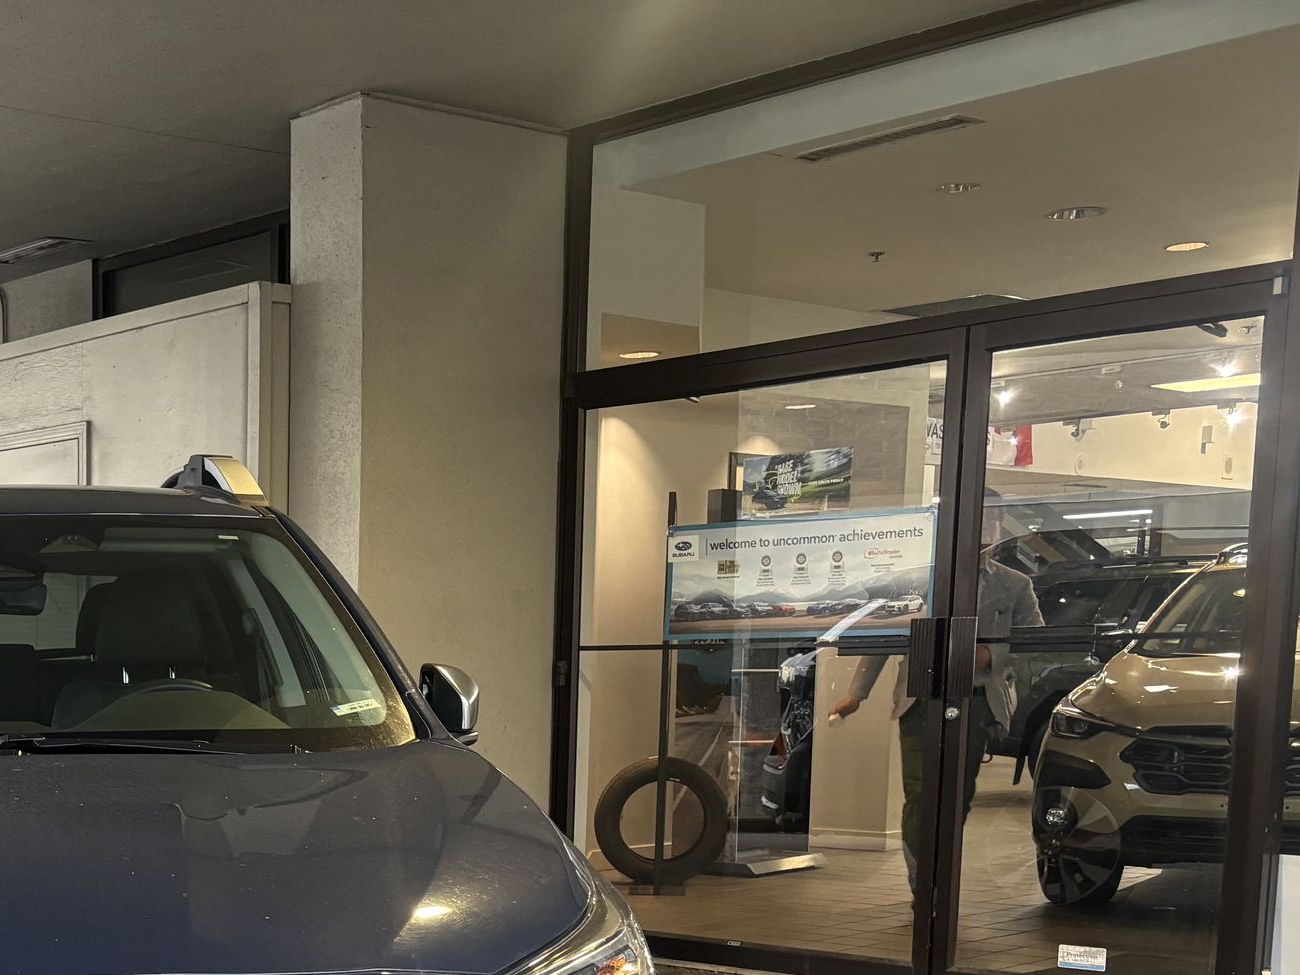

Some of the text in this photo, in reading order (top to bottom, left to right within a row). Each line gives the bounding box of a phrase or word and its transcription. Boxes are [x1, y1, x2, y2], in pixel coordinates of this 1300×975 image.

[710, 538, 757, 551] welcome
[759, 538, 770, 547] to
[838, 527, 924, 542] achievements
